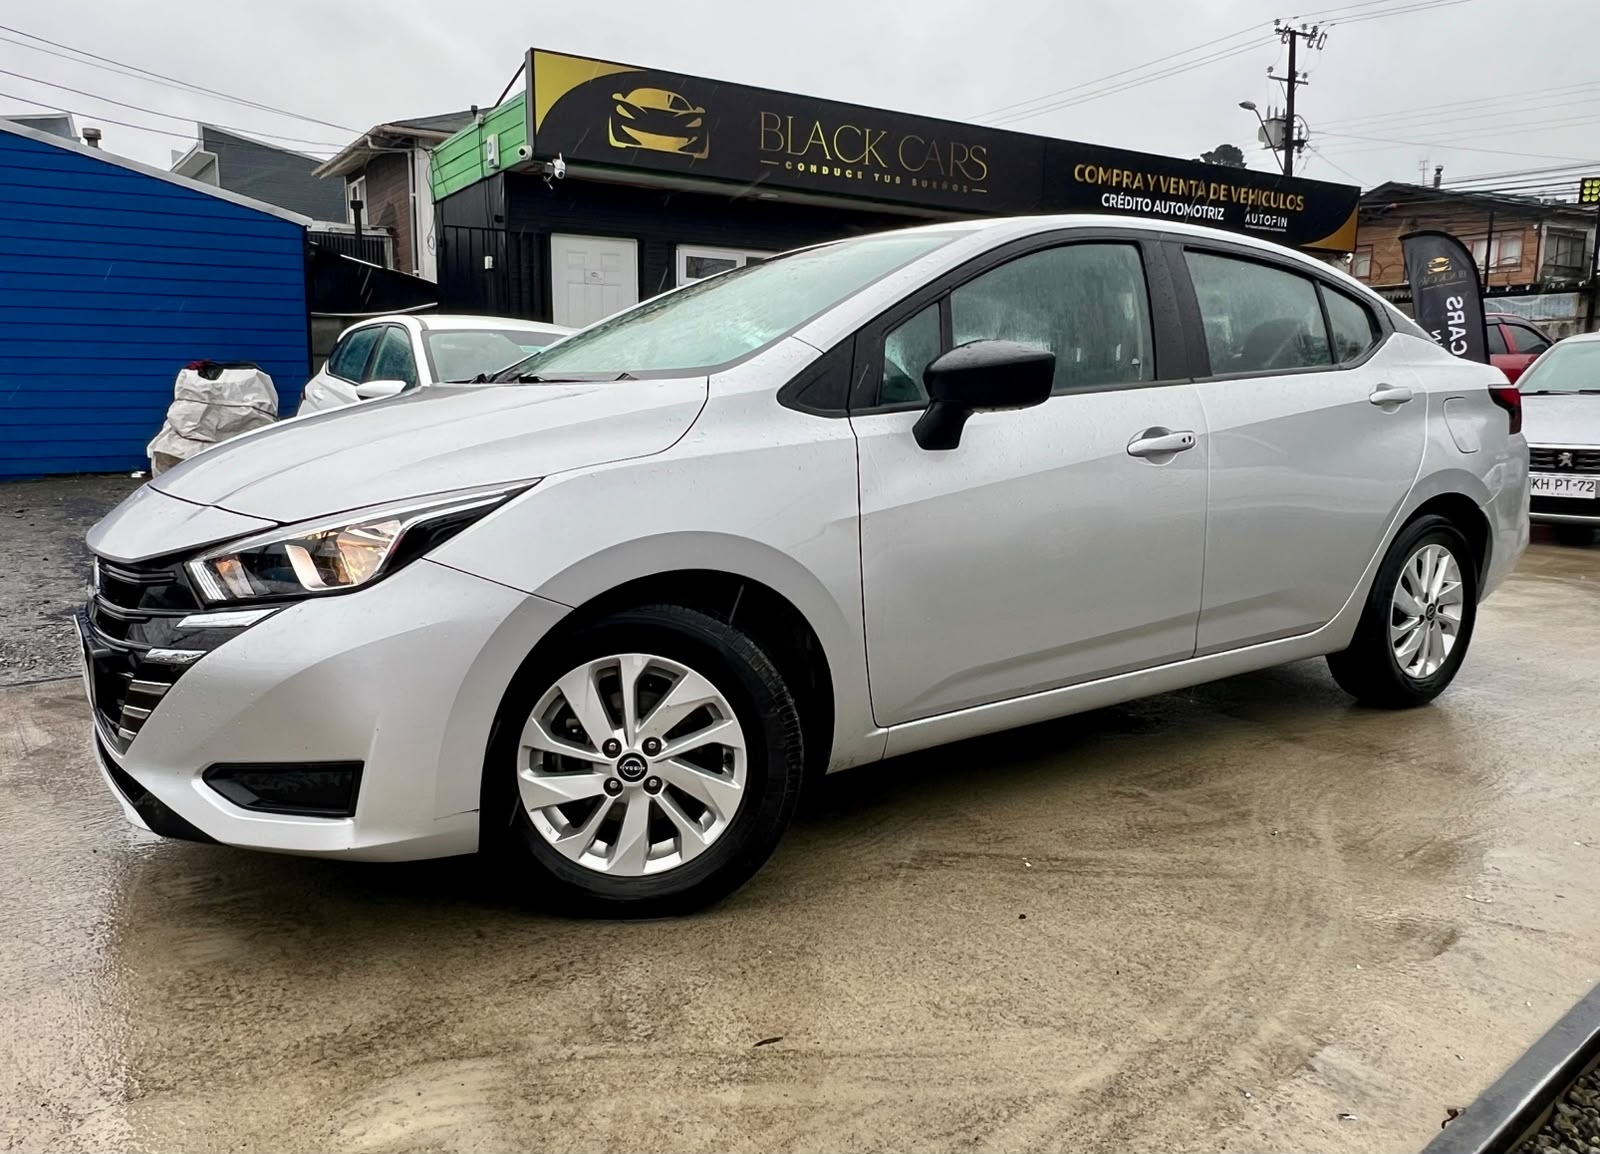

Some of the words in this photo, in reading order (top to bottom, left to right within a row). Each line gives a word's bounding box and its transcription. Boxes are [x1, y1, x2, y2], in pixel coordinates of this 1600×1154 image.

[759, 111, 888, 168] BLACK
[899, 134, 988, 182] CARS
[784, 160, 864, 179] CONDUCE
[1073, 163, 1144, 190] COMPRA
[1147, 173, 1160, 189] Y
[1159, 174, 1206, 197] VENTA
[1209, 182, 1228, 201] DE
[1101, 191, 1152, 212] CRÉDITO
[1153, 201, 1225, 220] AUTOMOTRIZ
[1244, 213, 1288, 228] AUTOFIN
